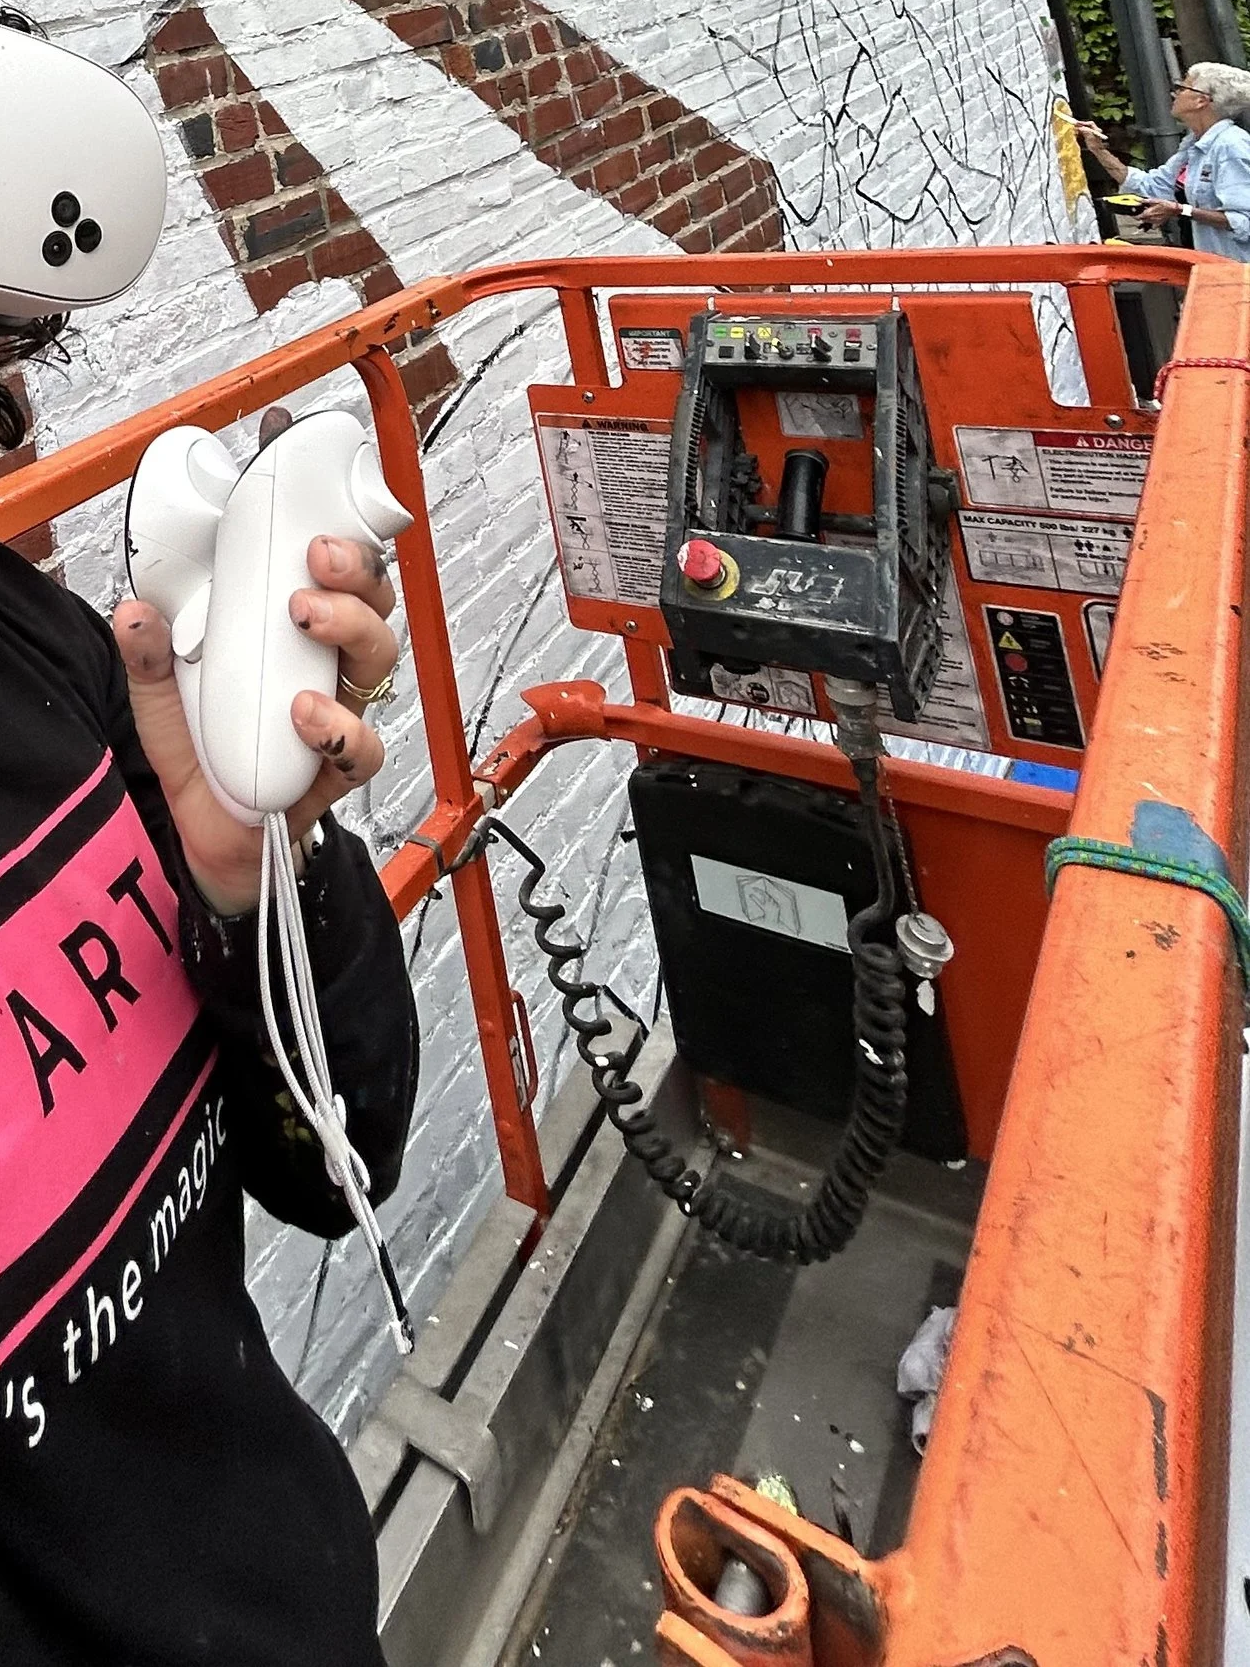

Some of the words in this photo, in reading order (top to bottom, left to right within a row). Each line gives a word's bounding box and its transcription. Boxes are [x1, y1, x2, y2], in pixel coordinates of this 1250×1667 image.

[627, 330, 671, 338] IMPORTANT
[596, 420, 650, 433] WARNING
[1093, 437, 1153, 452] DANGE
[963, 515, 986, 525] MAX
[987, 517, 1037, 529] CAPACITY
[1081, 525, 1099, 534] 227
[1102, 527, 1117, 537] kg
[5, 857, 175, 1119] ART
[61, 1258, 146, 1386] the
[150, 1094, 228, 1274] magic
